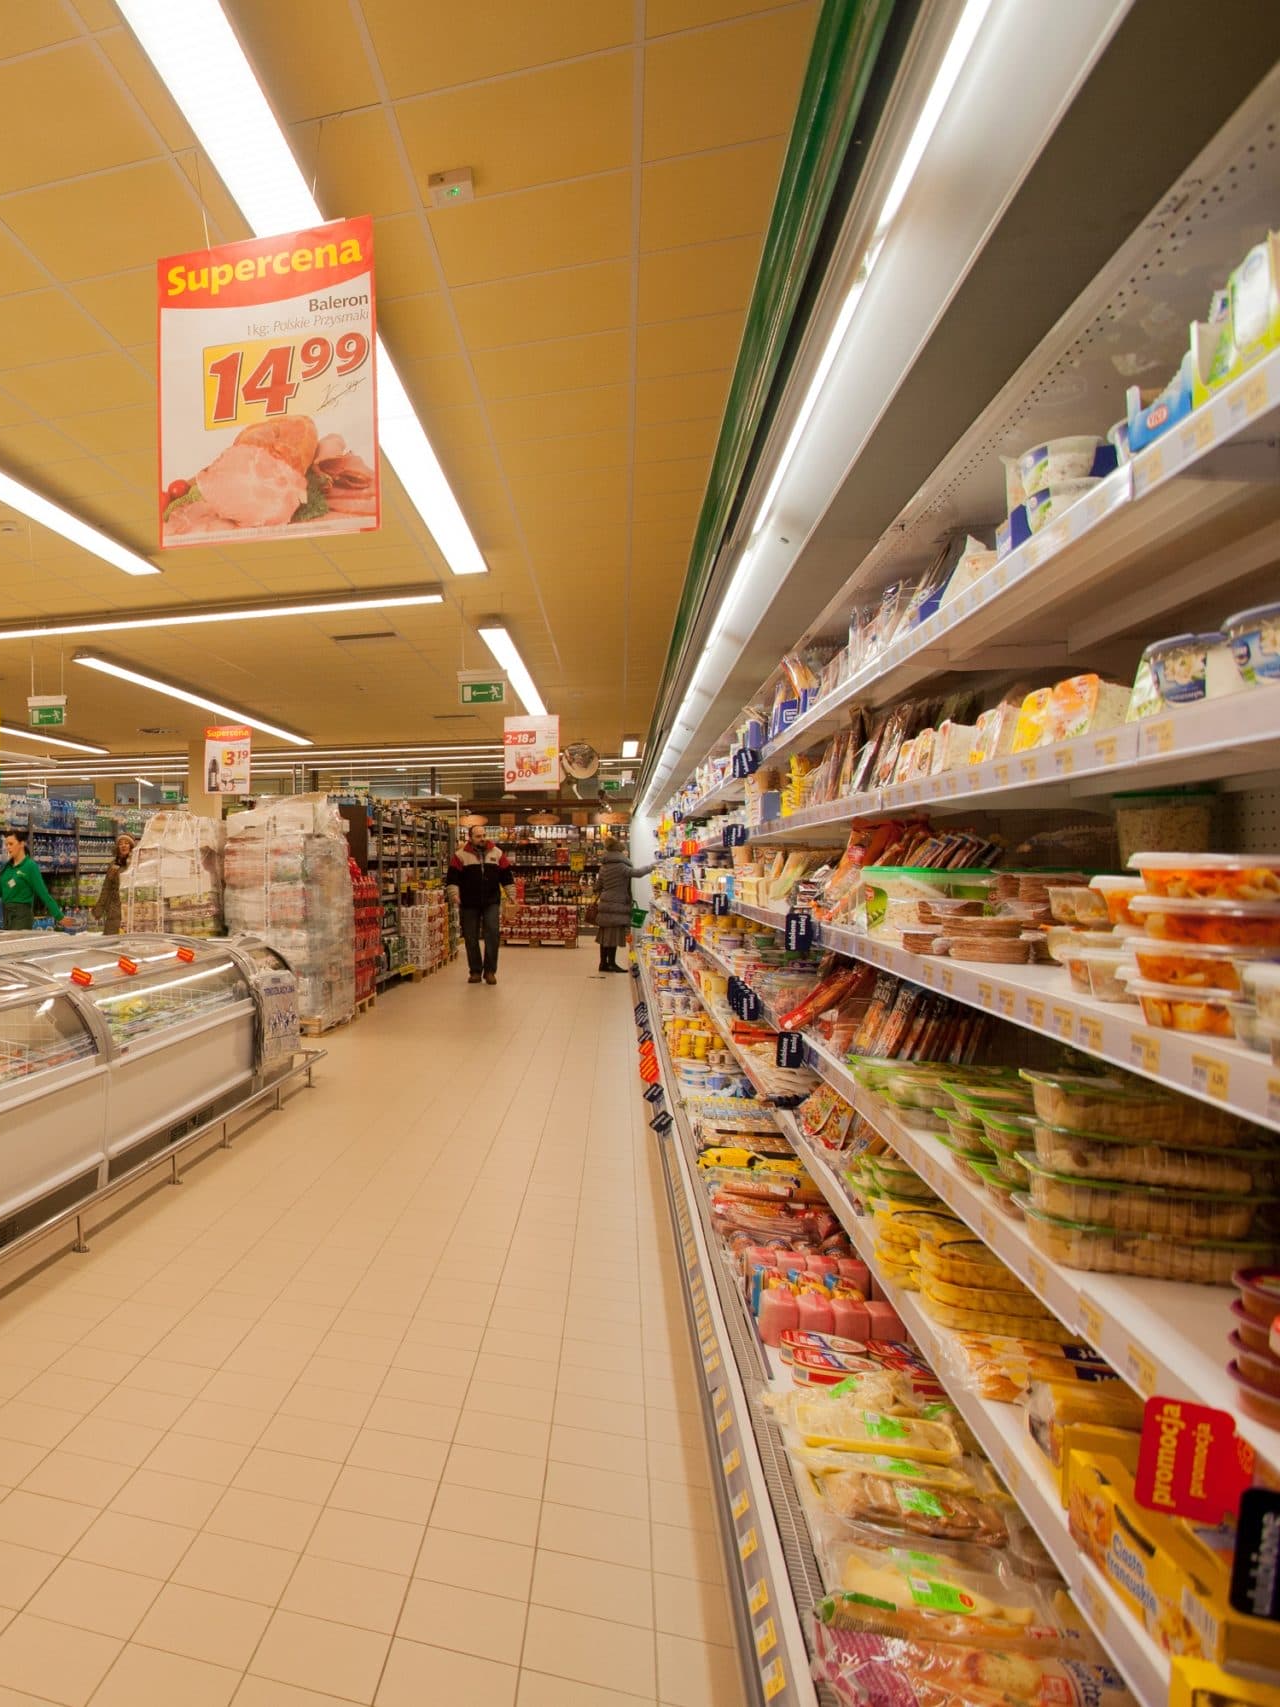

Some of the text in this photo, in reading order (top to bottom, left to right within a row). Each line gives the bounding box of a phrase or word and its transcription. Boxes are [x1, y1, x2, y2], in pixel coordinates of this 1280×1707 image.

[167, 238, 362, 297] Supercena
[273, 316, 311, 333] Polskie
[313, 309, 370, 327] Przysmaki
[308, 293, 370, 312] Baleron
[206, 729, 249, 739] Supercena
[1152, 1403, 1186, 1507] promocja
[1189, 1422, 1214, 1499] promocja
